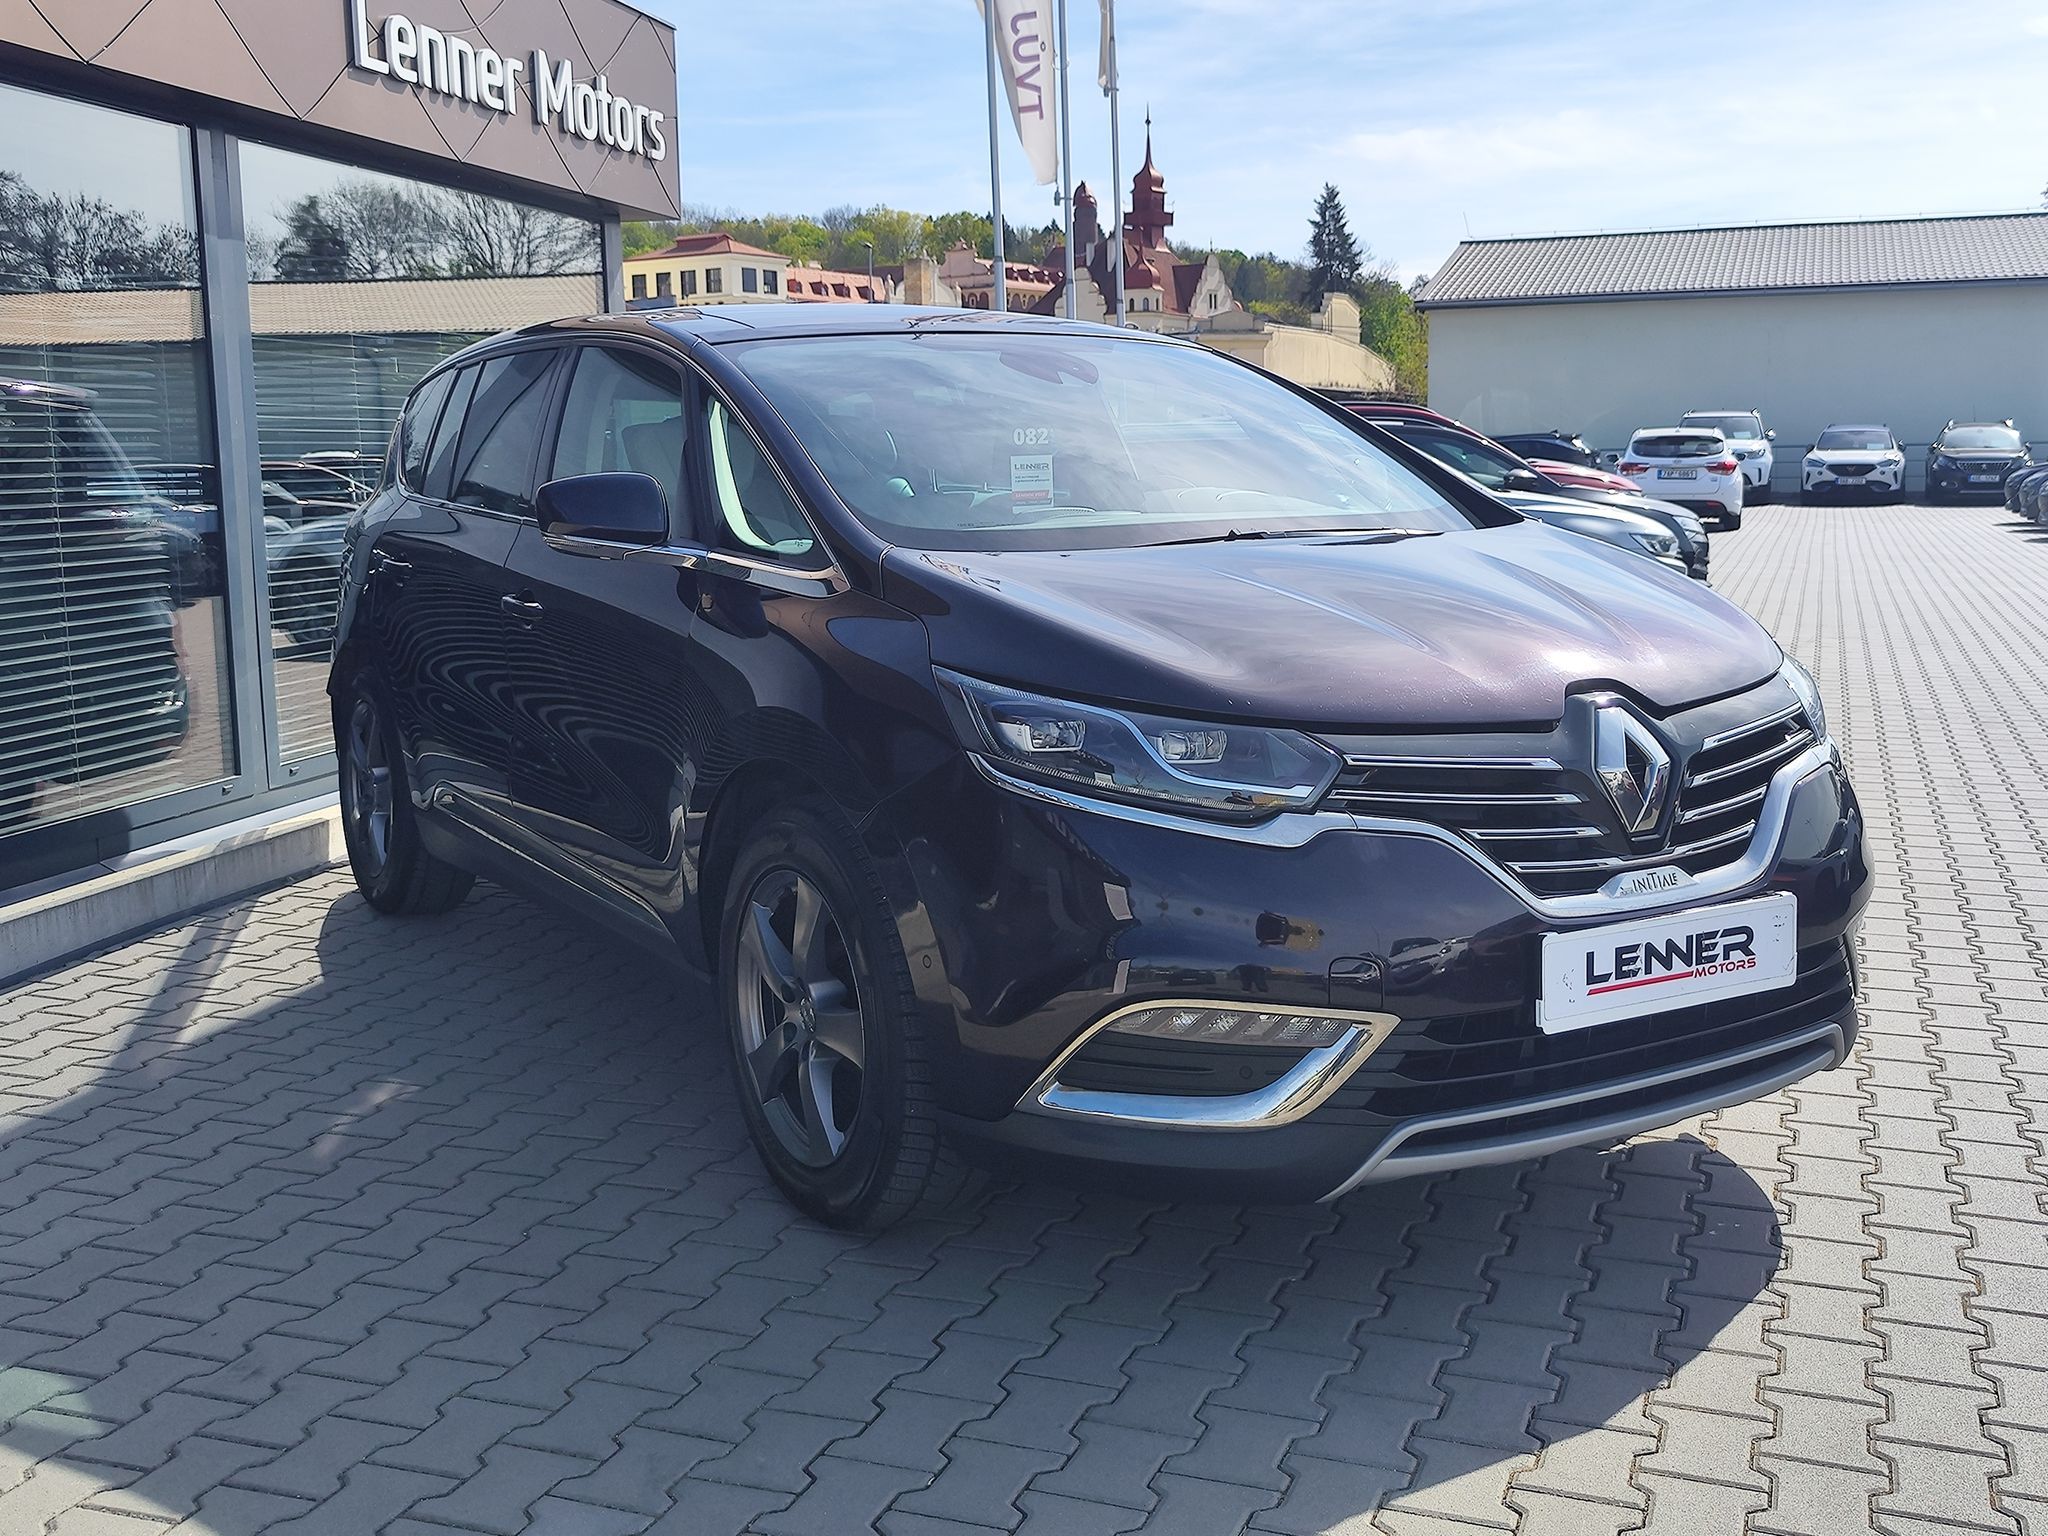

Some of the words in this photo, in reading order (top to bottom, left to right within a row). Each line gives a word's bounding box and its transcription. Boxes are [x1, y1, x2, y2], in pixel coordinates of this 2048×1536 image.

[351, 0, 524, 116] Lenner
[533, 49, 666, 161] Motors
[1013, 427, 1049, 446] 082
[1632, 871, 1678, 893] INITIALE
[1586, 925, 1756, 986] LENNER
[1693, 957, 1756, 979] MOTORS
